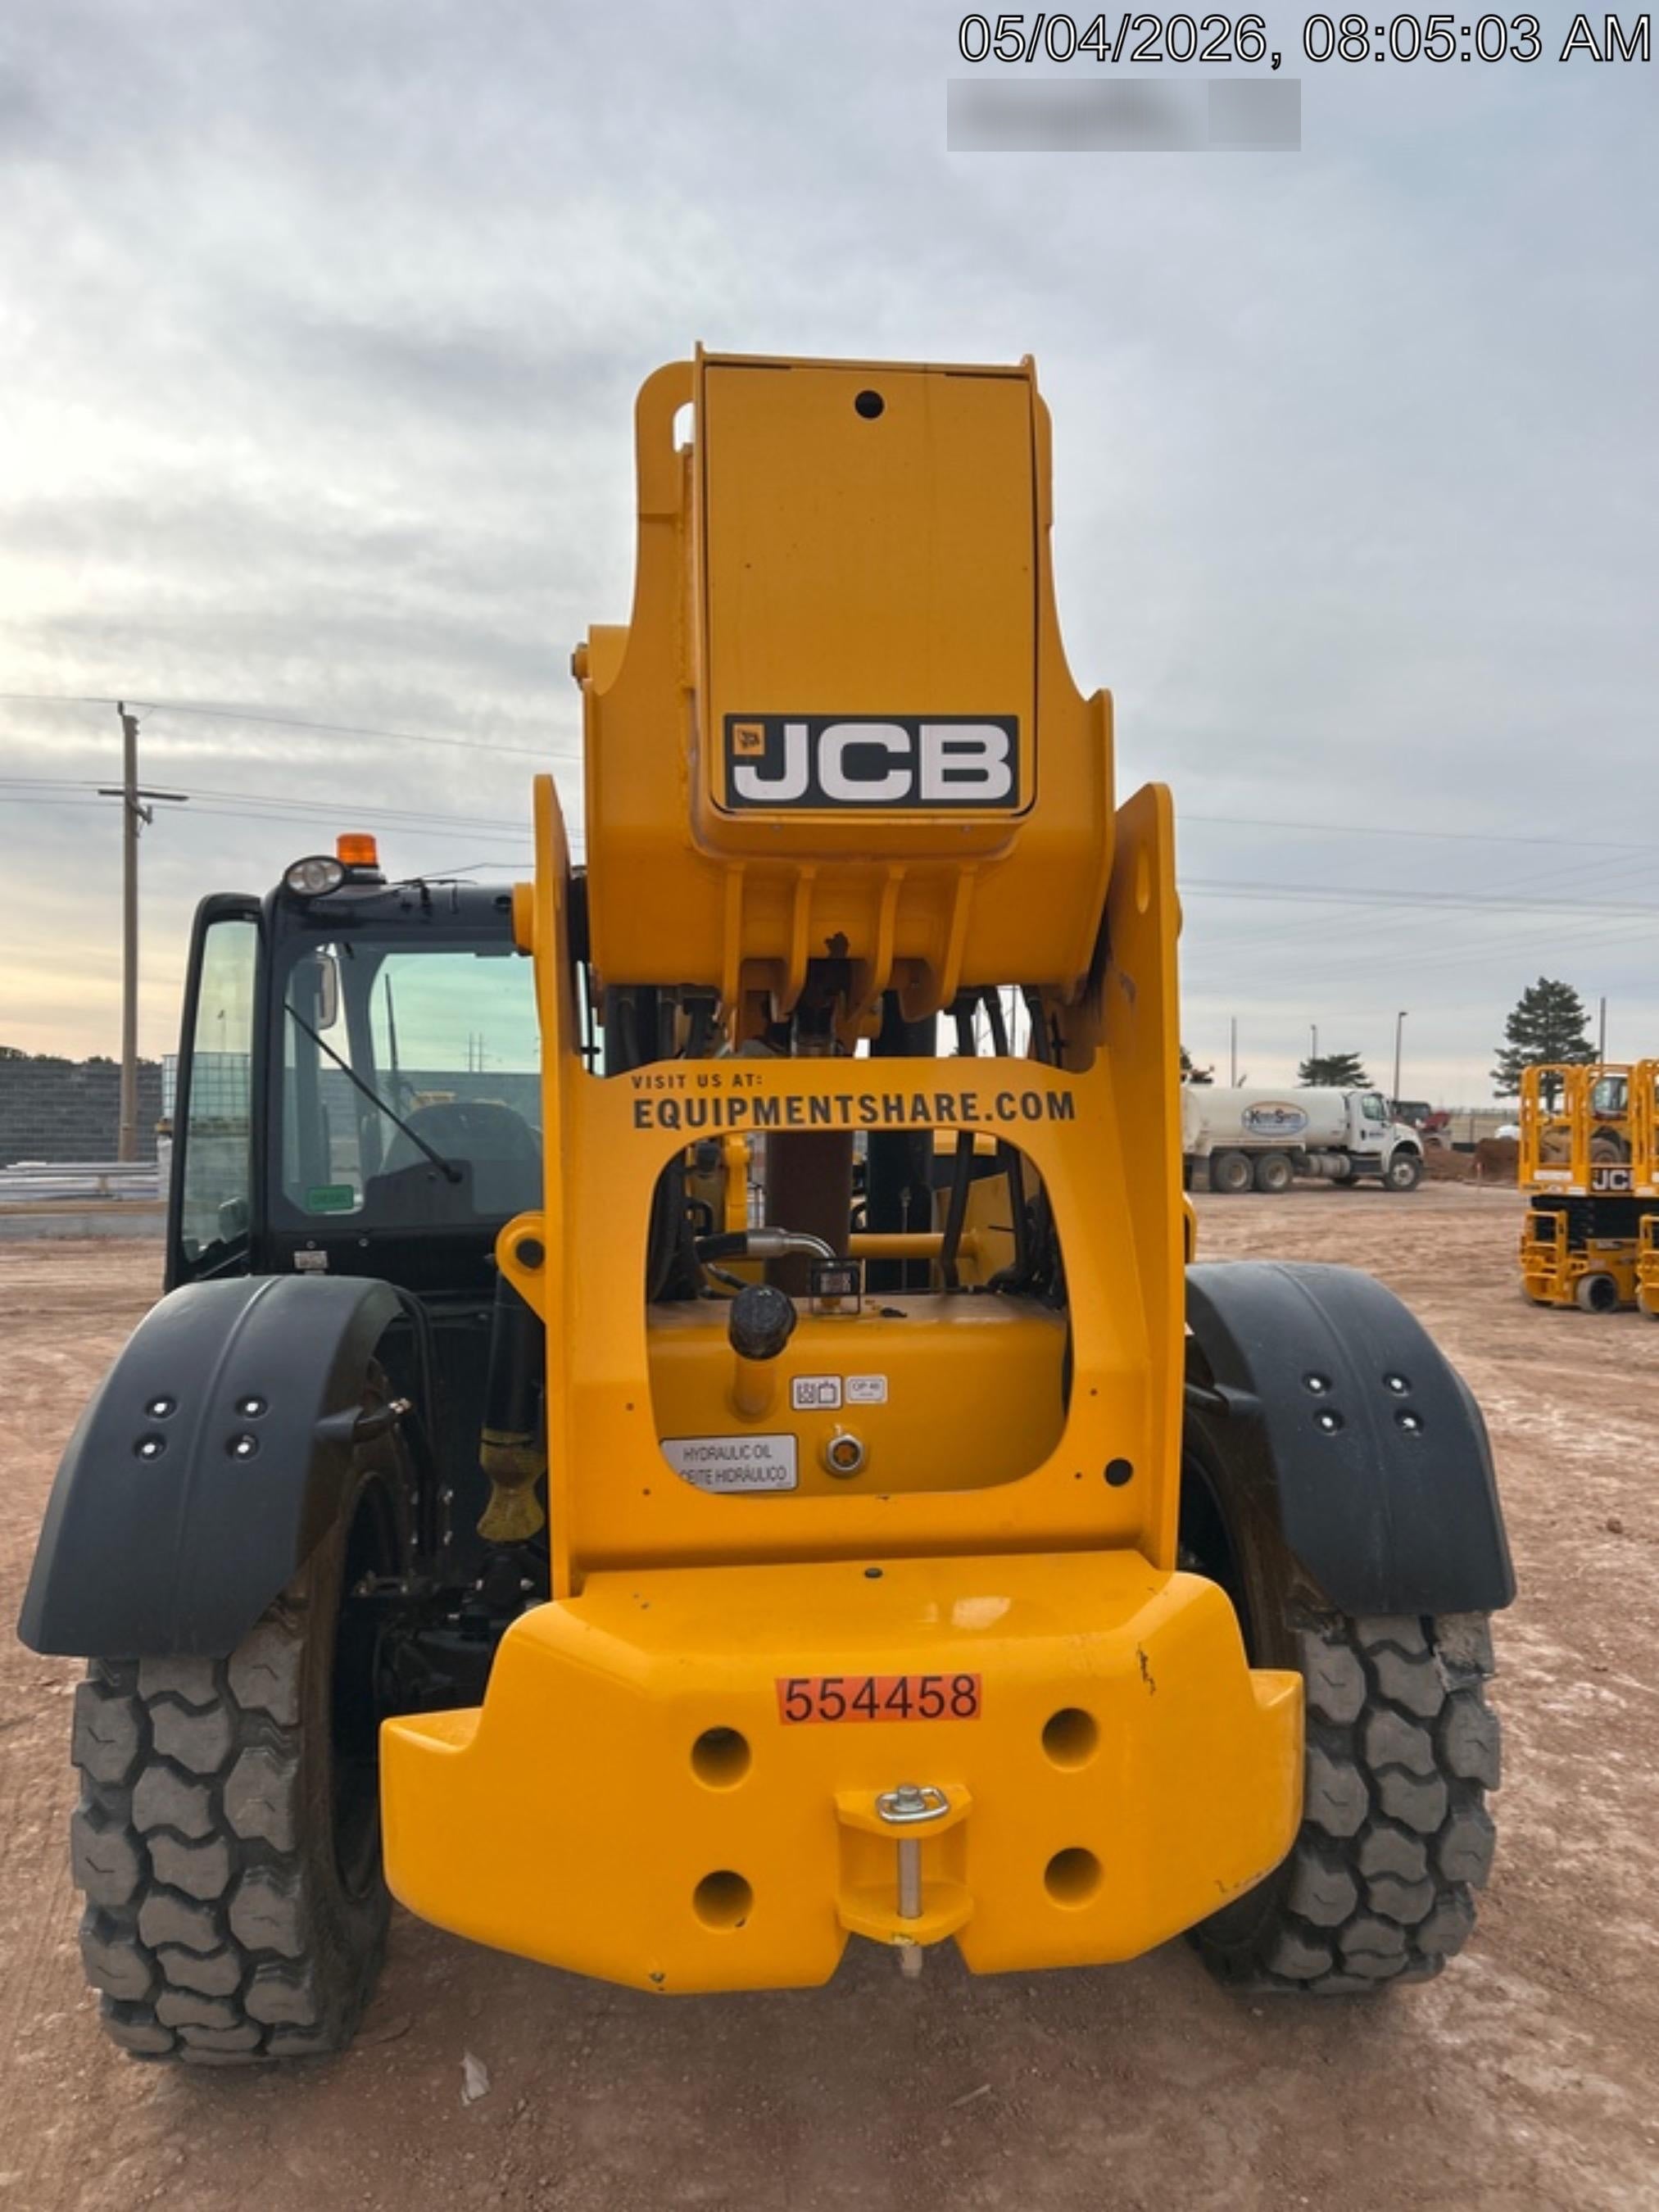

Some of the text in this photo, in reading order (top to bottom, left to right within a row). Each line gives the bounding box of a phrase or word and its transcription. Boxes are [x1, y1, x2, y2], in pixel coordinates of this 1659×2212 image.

[733, 723, 1013, 800] JCB
[631, 1072, 764, 1090] VISIT US AT:
[633, 1091, 1077, 1131] EQUIPMENTSHARE.COM
[1592, 1169, 1632, 1190] JC
[682, 1444, 773, 1462] HYDRAULIC OIL
[785, 1674, 977, 1722] 554458
